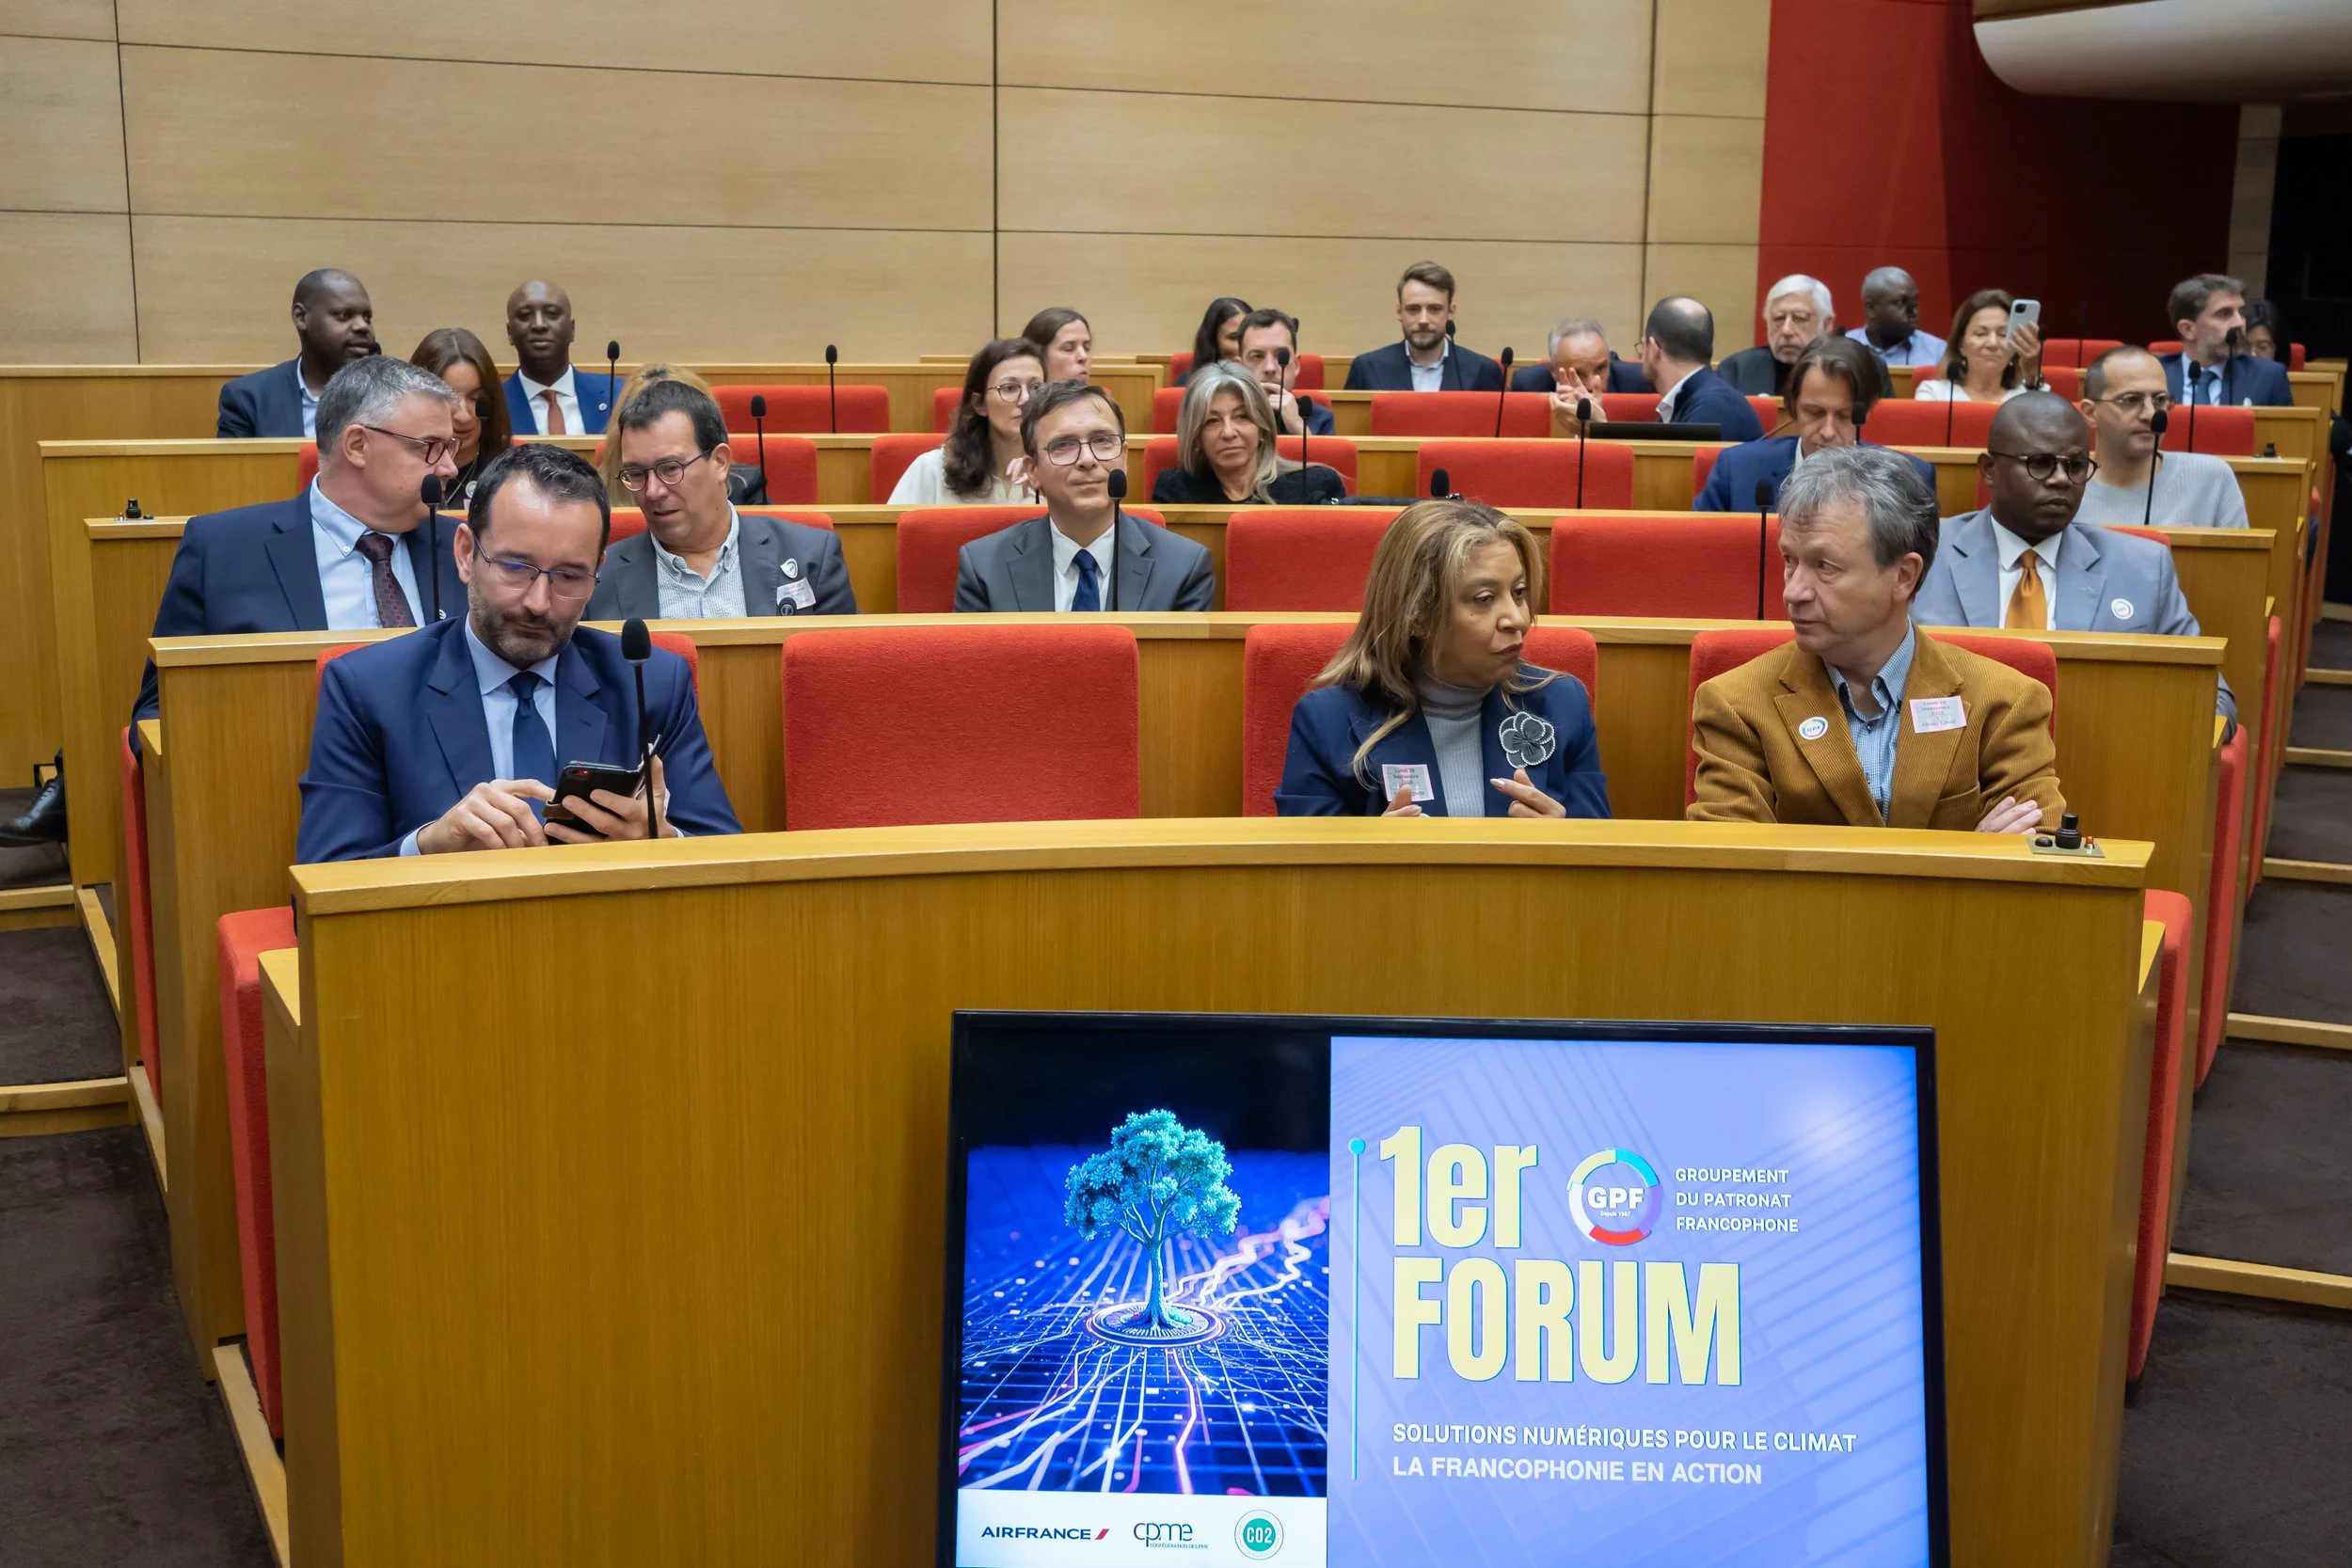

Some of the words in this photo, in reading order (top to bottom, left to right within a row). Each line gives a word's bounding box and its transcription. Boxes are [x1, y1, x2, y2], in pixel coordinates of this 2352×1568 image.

[1675, 1167, 1789, 1183] GROUPEMENT
[1380, 1126, 1538, 1249] 1er
[1587, 1186, 1645, 1210] GPF
[1676, 1192, 1699, 1206] DU
[1704, 1193, 1792, 1208] PATRONAT
[1676, 1216, 1799, 1232] FRANCOPHONE
[1392, 1257, 1741, 1386] FORUM
[1392, 1423, 1517, 1445] SOLUTIONS
[1523, 1424, 1669, 1450] NUMÉRIQUES
[1675, 1430, 1737, 1449] POUR
[1742, 1433, 1768, 1450] LE
[1773, 1432, 1857, 1452] CLIMAT
[1393, 1456, 1424, 1476] LA
[1432, 1457, 1625, 1481] FRANCOPHONIE
[1631, 1461, 1664, 1482] EN
[1671, 1462, 1762, 1484] ACTION
[980, 1526, 1091, 1541] AIRFRANCE
[1133, 1522, 1193, 1547] cpme
[1247, 1527, 1273, 1544] CO2
